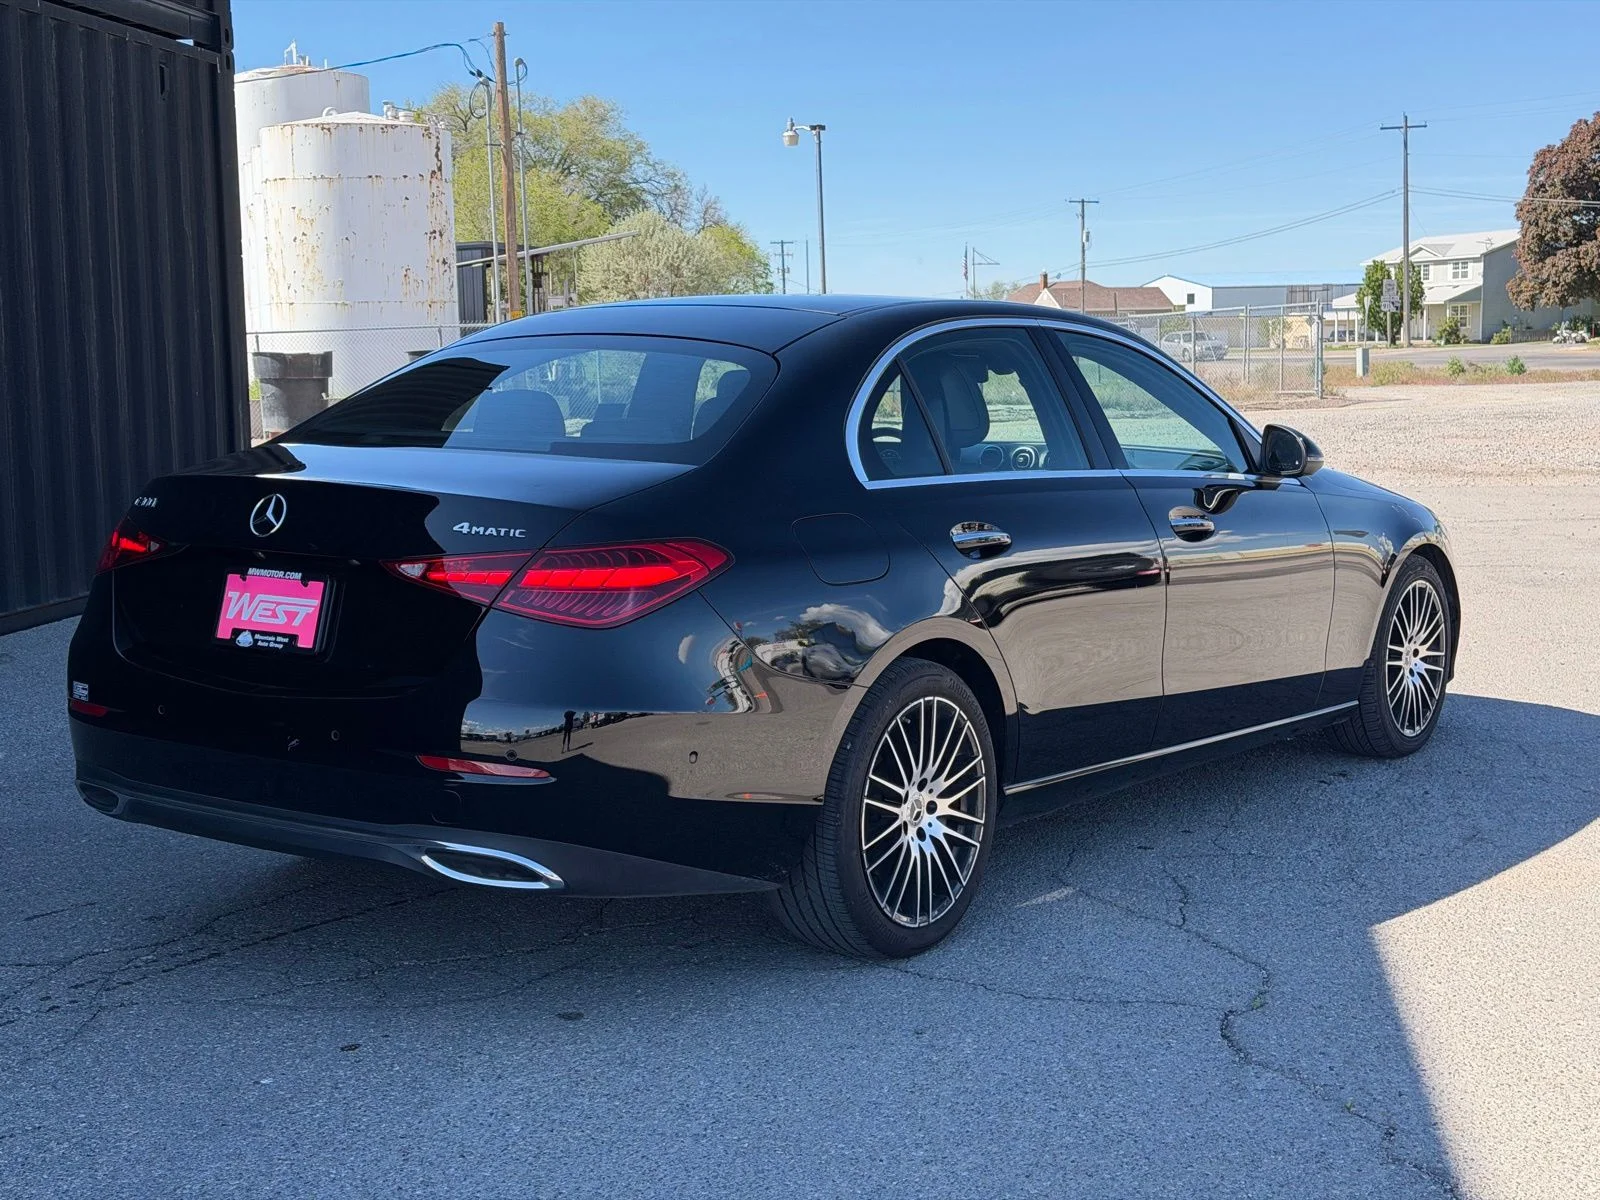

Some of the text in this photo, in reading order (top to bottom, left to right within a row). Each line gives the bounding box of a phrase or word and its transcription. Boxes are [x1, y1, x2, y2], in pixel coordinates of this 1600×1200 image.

[452, 522, 527, 538] 4MATIC
[247, 567, 302, 580] MWMOTOR.COM
[225, 591, 319, 627] WEST
[254, 633, 289, 643] Mountain West
[269, 641, 284, 650] Group
